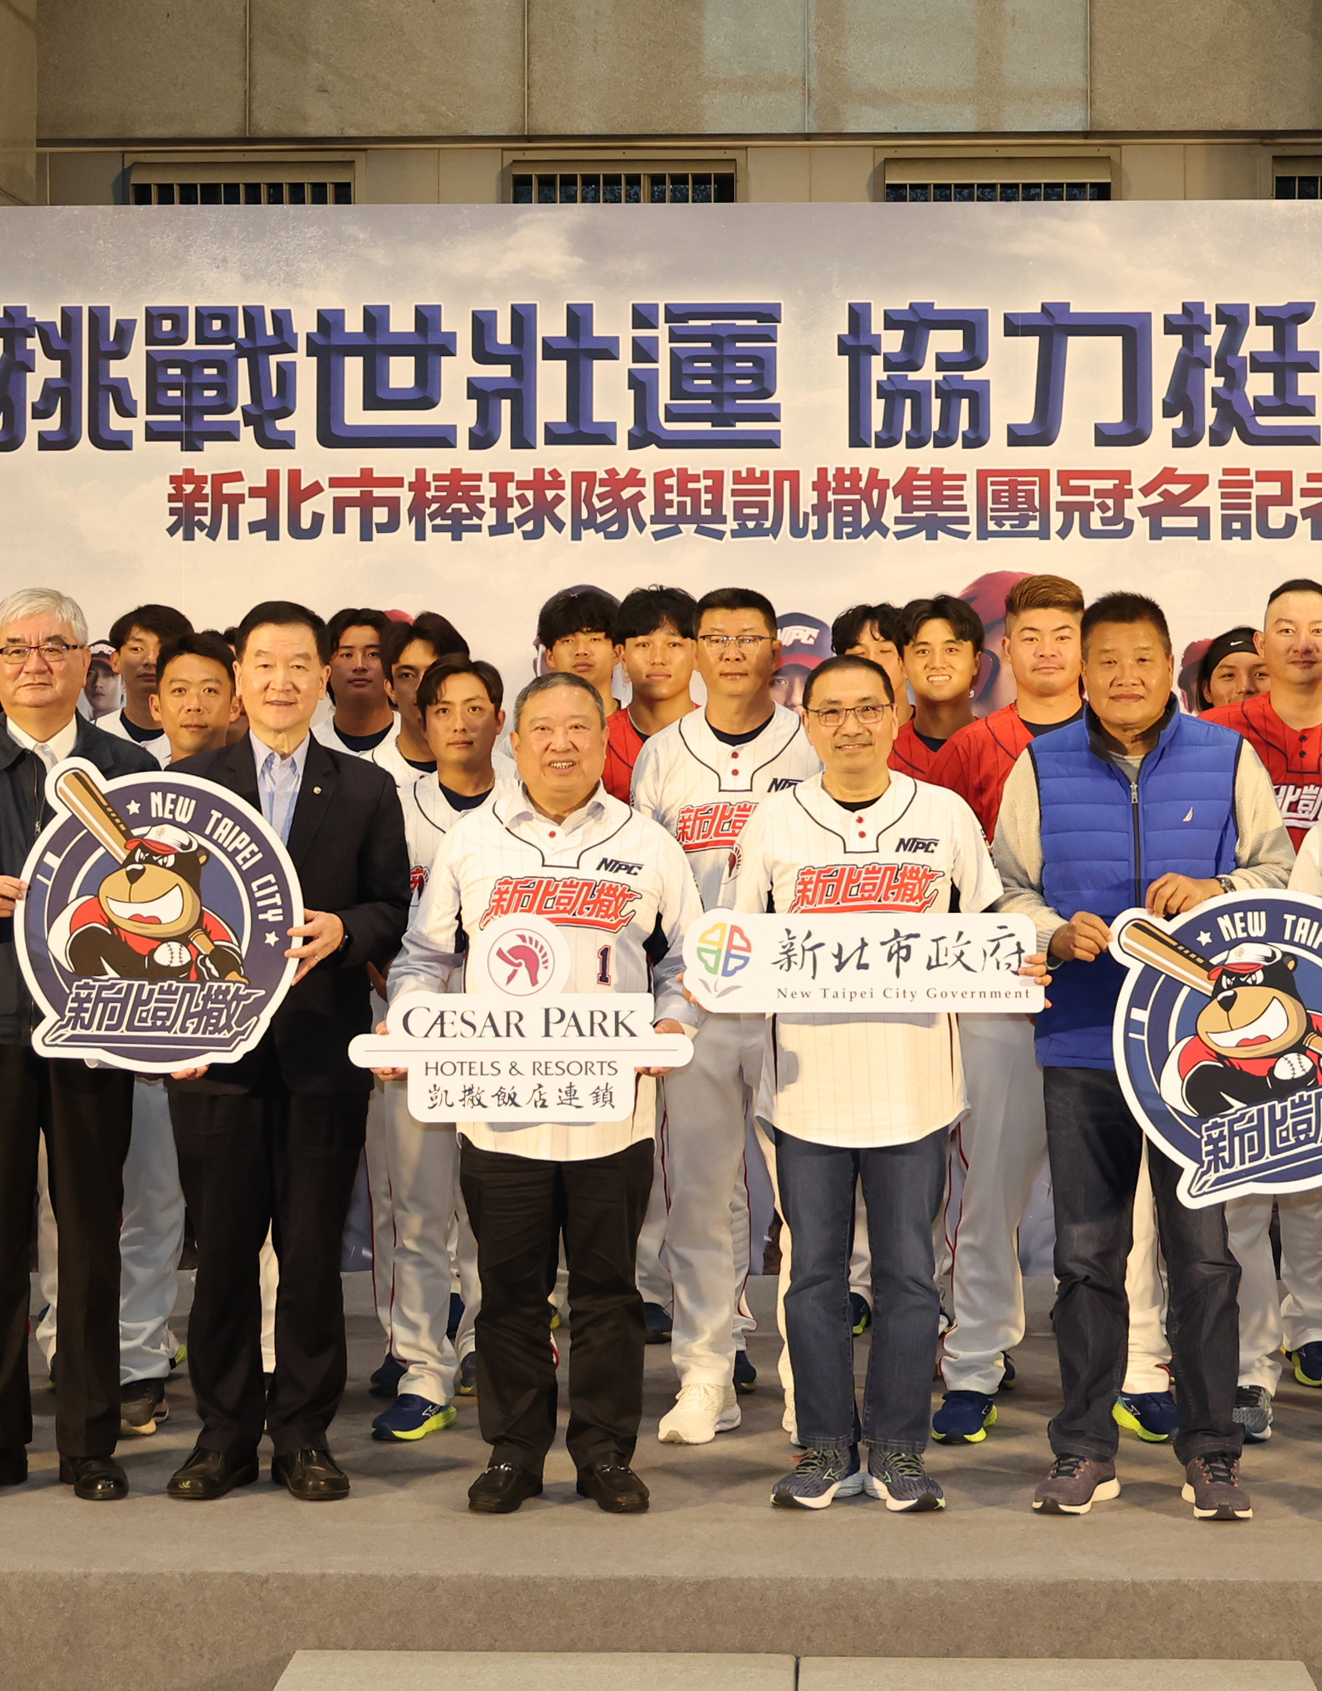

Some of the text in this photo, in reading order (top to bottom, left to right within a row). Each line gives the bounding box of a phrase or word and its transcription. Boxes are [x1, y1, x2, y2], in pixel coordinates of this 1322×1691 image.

[150, 791, 284, 922] NEW TAIPEI CITY
[895, 838, 940, 853] NTPC
[596, 858, 645, 876] NTPC
[485, 876, 642, 926] 新北凱撒
[791, 863, 945, 912] 新北凱撒
[1216, 911, 1267, 942] NEW
[597, 945, 611, 986] 1
[770, 926, 1027, 980] 新北市政府
[57, 979, 267, 1042] 新北凱撒
[776, 987, 1031, 1002] New Taipei City Government
[402, 1006, 639, 1038] CÆSAR PARK
[424, 1060, 618, 1076] HOTELS & RESORTS
[426, 1083, 616, 1110] 凱撒飯店連鎖
